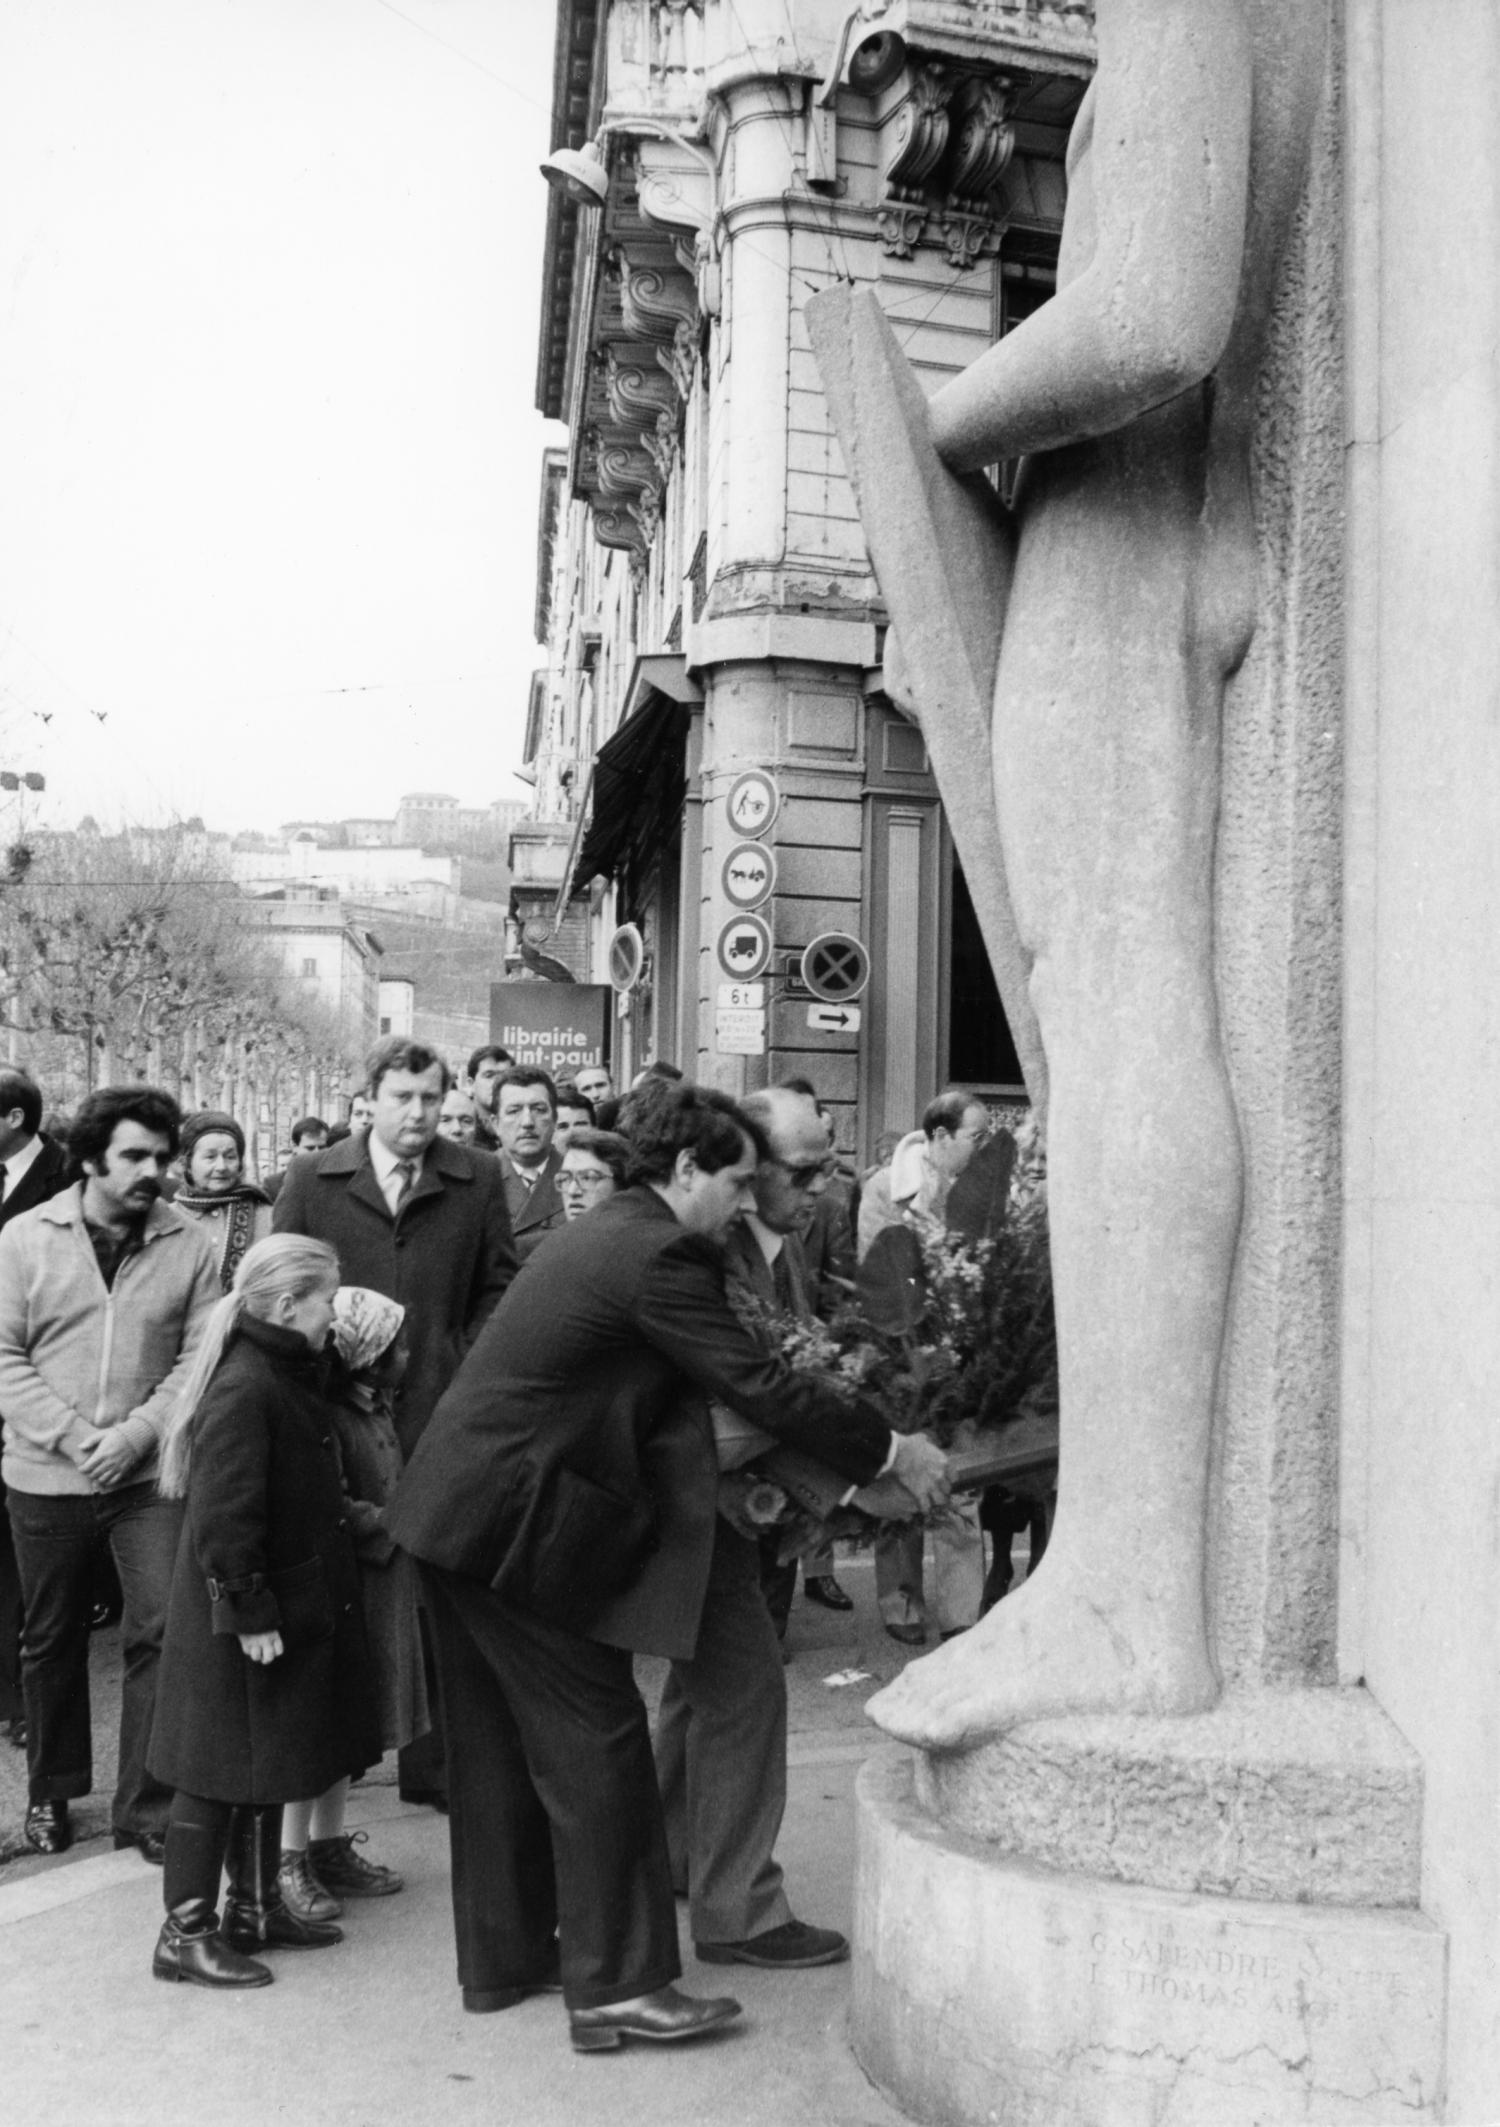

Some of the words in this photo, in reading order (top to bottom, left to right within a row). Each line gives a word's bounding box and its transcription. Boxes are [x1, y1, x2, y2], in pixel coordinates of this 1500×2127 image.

[731, 988, 740, 1005] 6
[744, 992, 749, 1005] t
[503, 1025, 588, 1047] librairie
[1122, 1969, 1248, 2009] THOMAS
